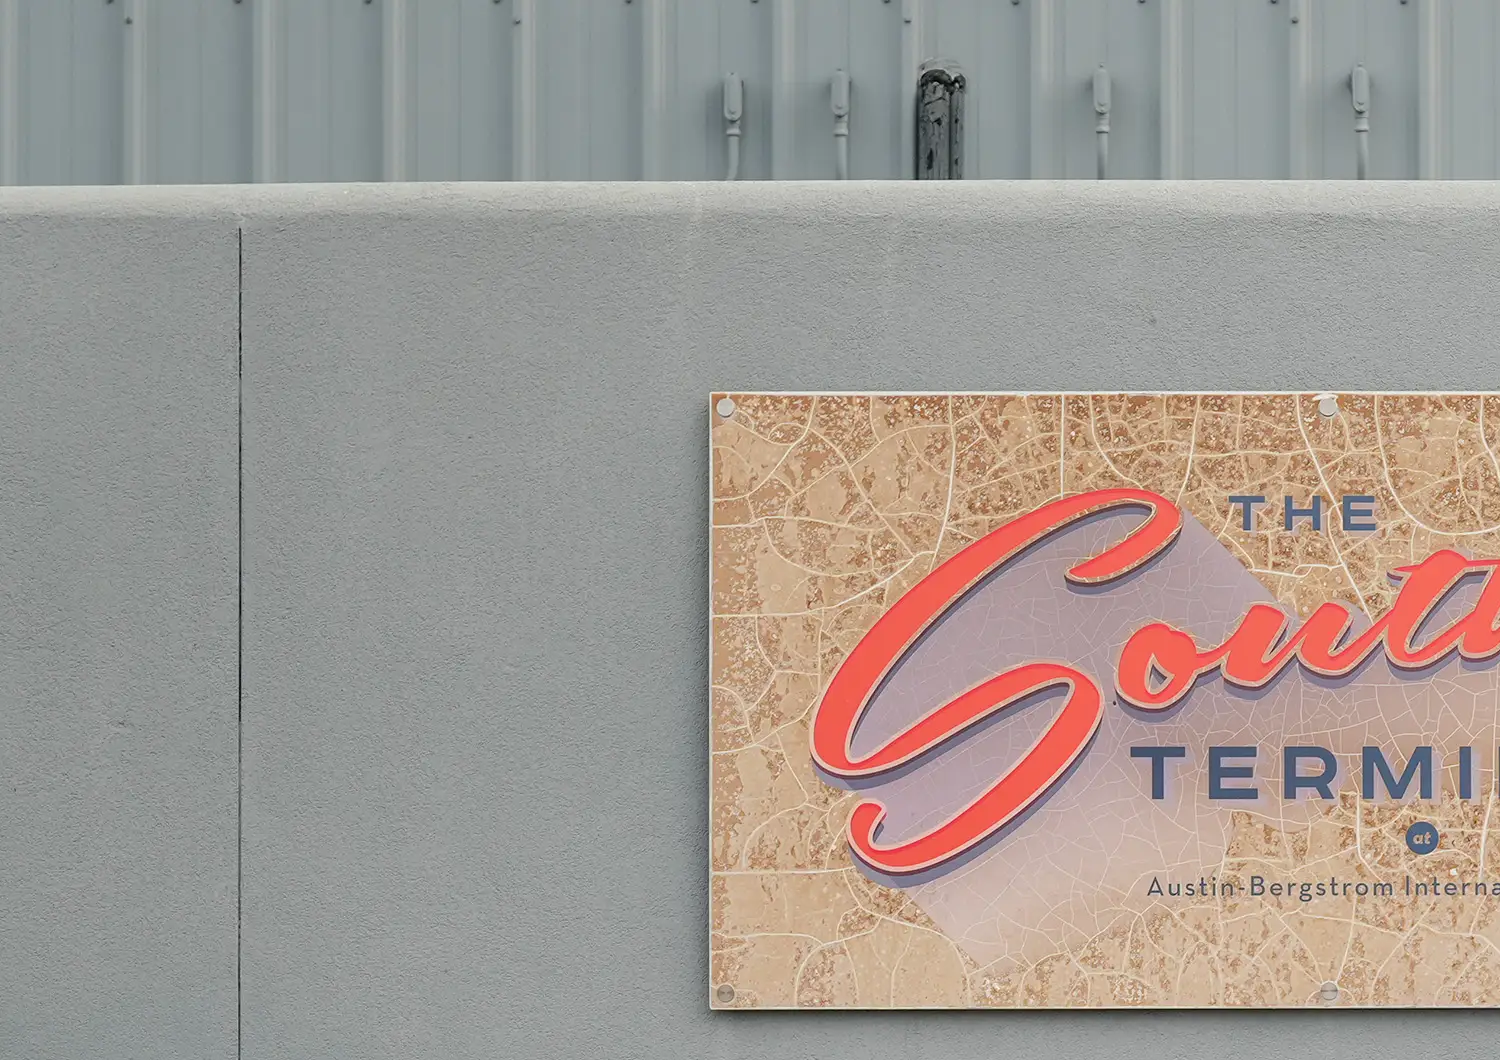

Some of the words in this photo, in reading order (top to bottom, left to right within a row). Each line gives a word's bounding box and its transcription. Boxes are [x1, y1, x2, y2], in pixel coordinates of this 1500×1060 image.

[1230, 495, 1377, 532] THE
[1412, 829, 1432, 847] at
[1146, 874, 1395, 901] Austin-Bergstrom
